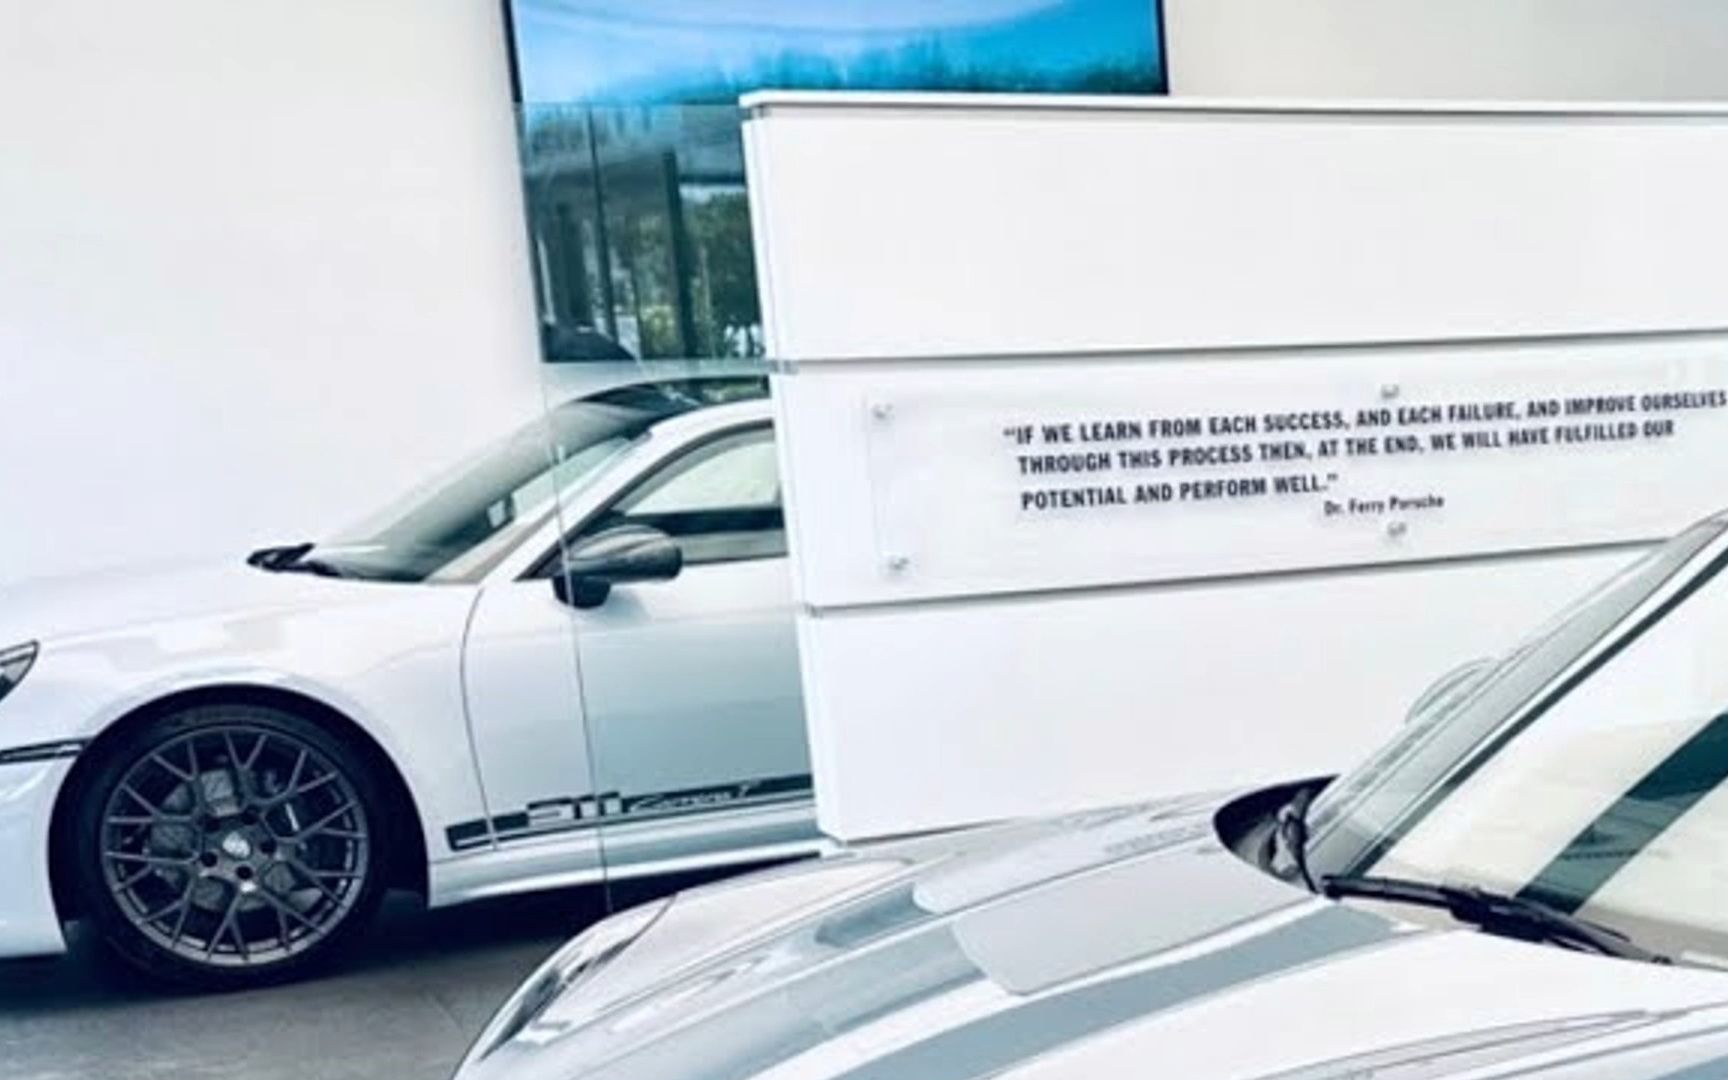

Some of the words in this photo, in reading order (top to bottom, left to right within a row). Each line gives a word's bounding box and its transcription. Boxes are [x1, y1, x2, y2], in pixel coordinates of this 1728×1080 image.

[1042, 424, 1073, 443] WE
[1080, 420, 1141, 442] LEARN
[1149, 417, 1201, 438] FROM
[1209, 413, 1256, 435] EACH
[1263, 410, 1349, 433] SUCCESS,
[1357, 410, 1391, 427] AND
[1400, 404, 1441, 424] EACH
[1449, 401, 1521, 422] FAILURE,
[1527, 399, 1560, 418] AND
[1565, 394, 1635, 414] IMPROVE
[1640, 390, 1727, 412] OURSELVES
[1018, 455, 1110, 475] THROUGH
[1118, 450, 1162, 468] THIS
[1169, 445, 1252, 467] PROCESS
[1258, 441, 1312, 460] THEN,
[1318, 439, 1339, 457] AT
[1345, 437, 1377, 455] THE
[1384, 435, 1424, 454] END,
[1431, 432, 1455, 451] WE
[1462, 430, 1501, 449] WILL
[1508, 427, 1548, 446] HAVE
[1554, 421, 1637, 444] FULFILLED
[1643, 420, 1674, 436] OUR
[1021, 486, 1127, 510] POTENTIAL
[1134, 483, 1172, 503] AND
[1179, 477, 1267, 499] PERFORM
[1324, 500, 1344, 516] Dr.
[1349, 497, 1385, 515] Ferry
[1389, 494, 1444, 511] Porsche
